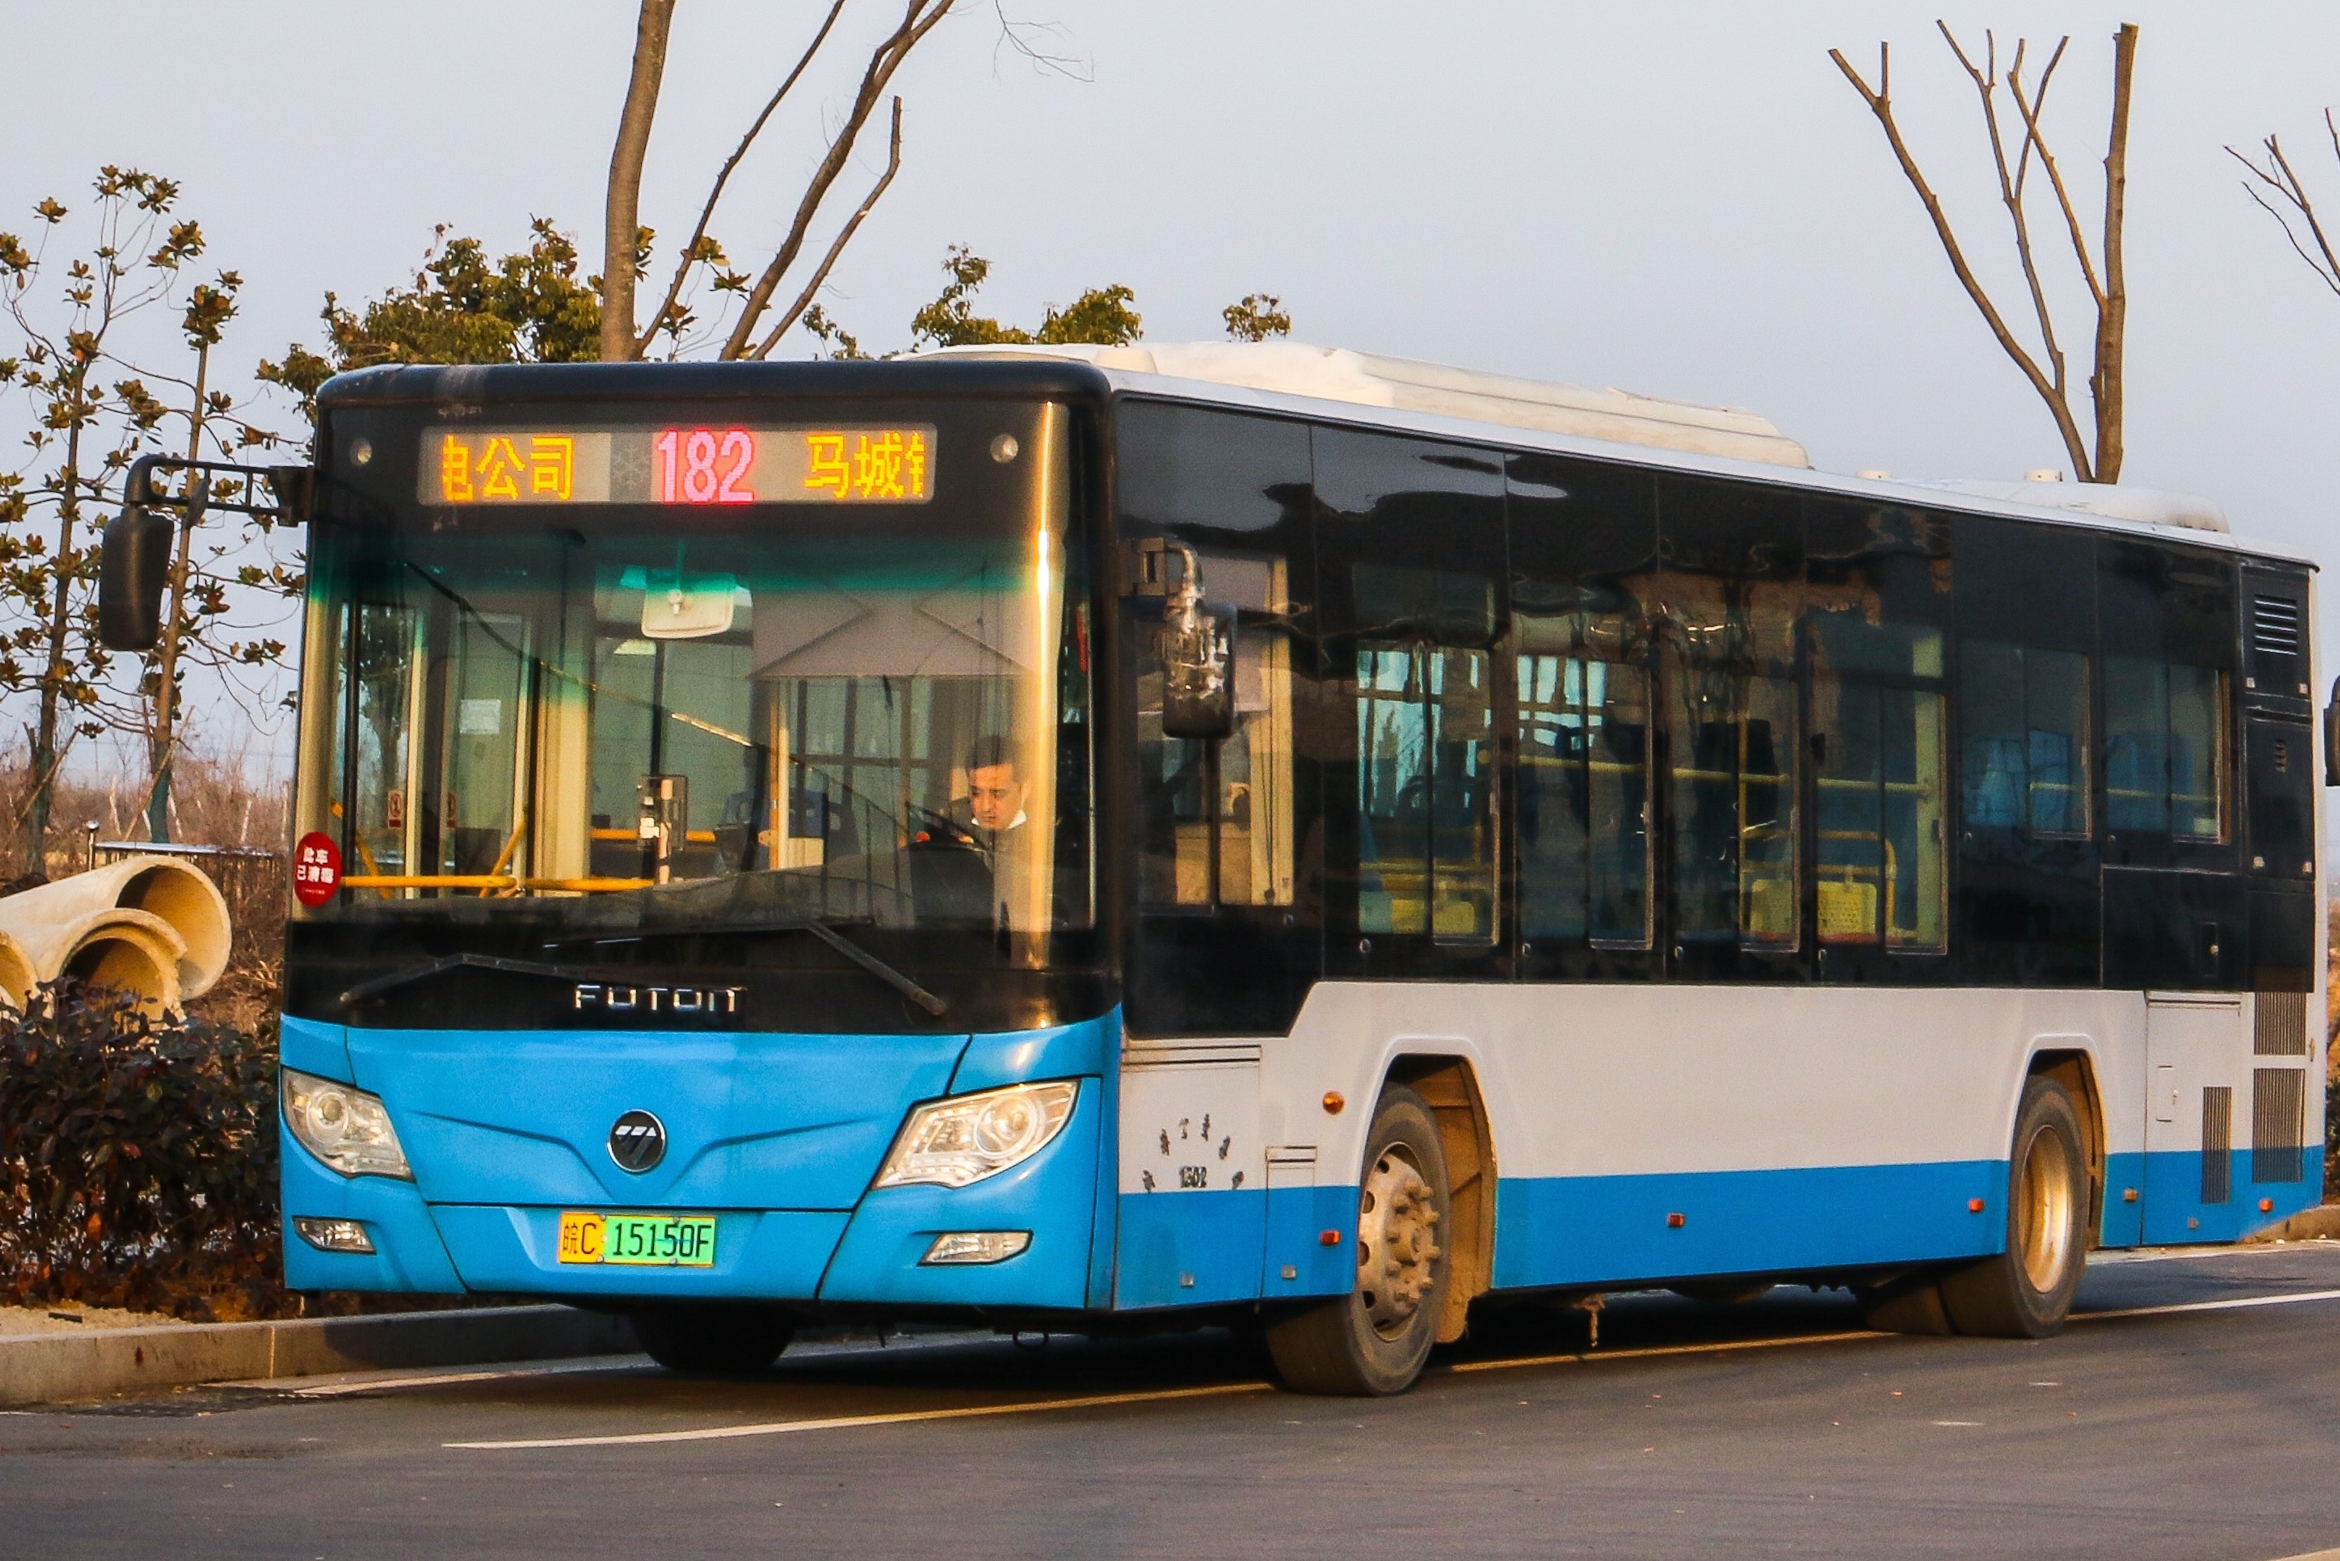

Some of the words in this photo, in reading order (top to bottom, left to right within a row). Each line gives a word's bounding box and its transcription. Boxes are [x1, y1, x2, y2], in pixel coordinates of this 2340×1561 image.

[657, 430, 754, 504] 182
[575, 983, 740, 1012] FOTON
[612, 1222, 713, 1259] 15150F
